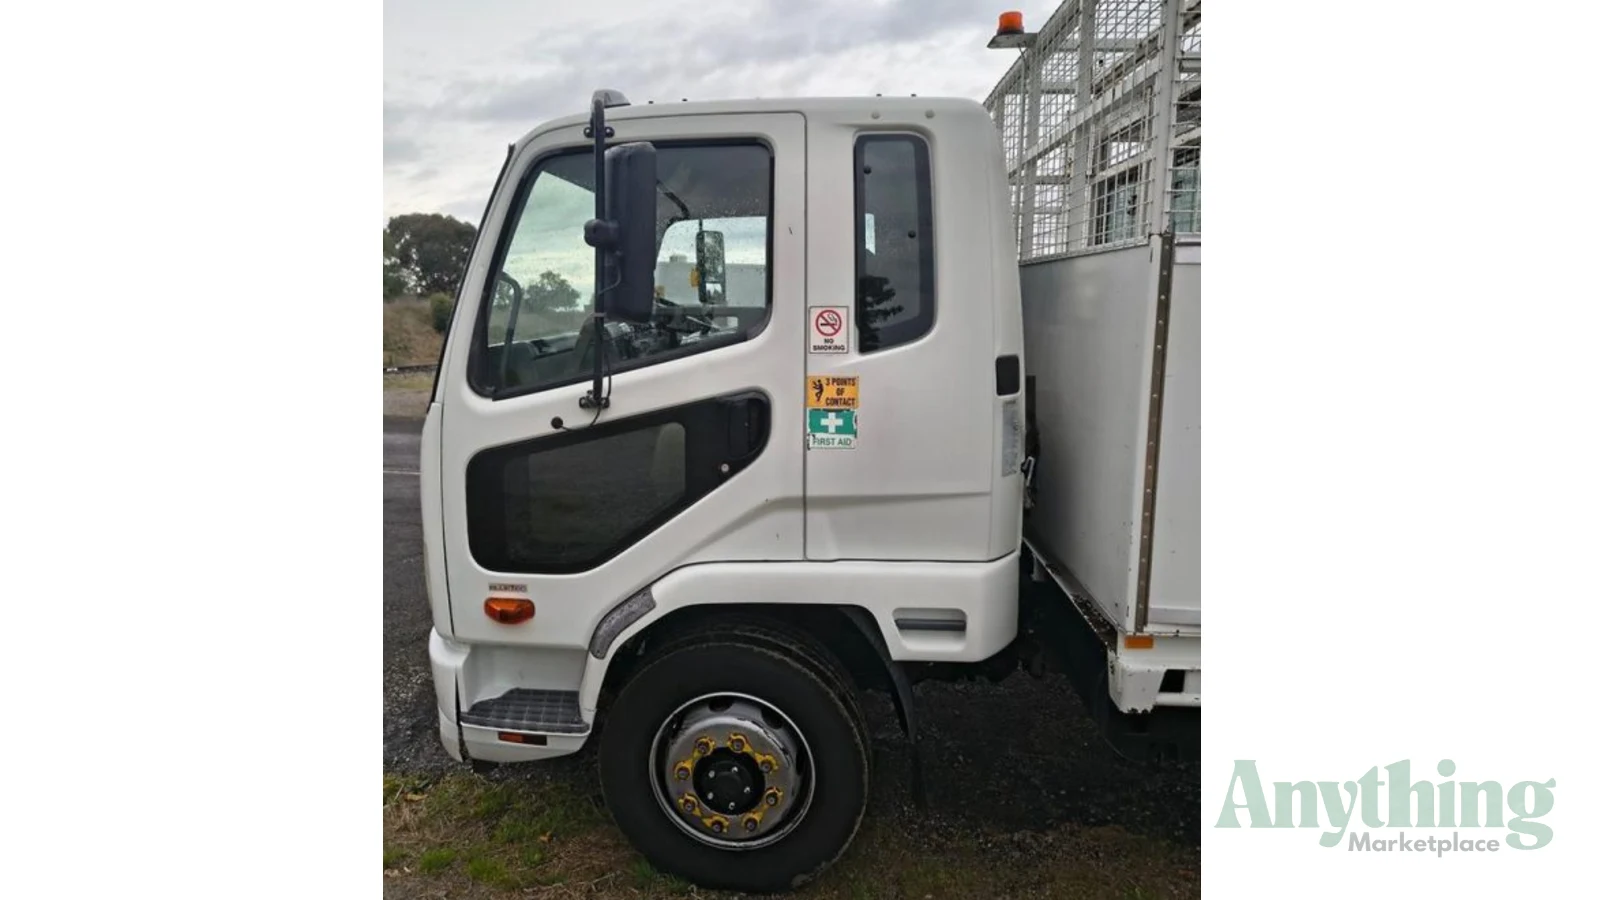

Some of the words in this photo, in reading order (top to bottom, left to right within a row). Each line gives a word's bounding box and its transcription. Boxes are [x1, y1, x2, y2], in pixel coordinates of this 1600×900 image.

[825, 378, 830, 386] 3
[831, 378, 856, 387] POINTS
[836, 388, 845, 396] OF
[825, 398, 856, 407] CONTACT
[812, 438, 836, 446] FIRST
[837, 438, 852, 446] AID
